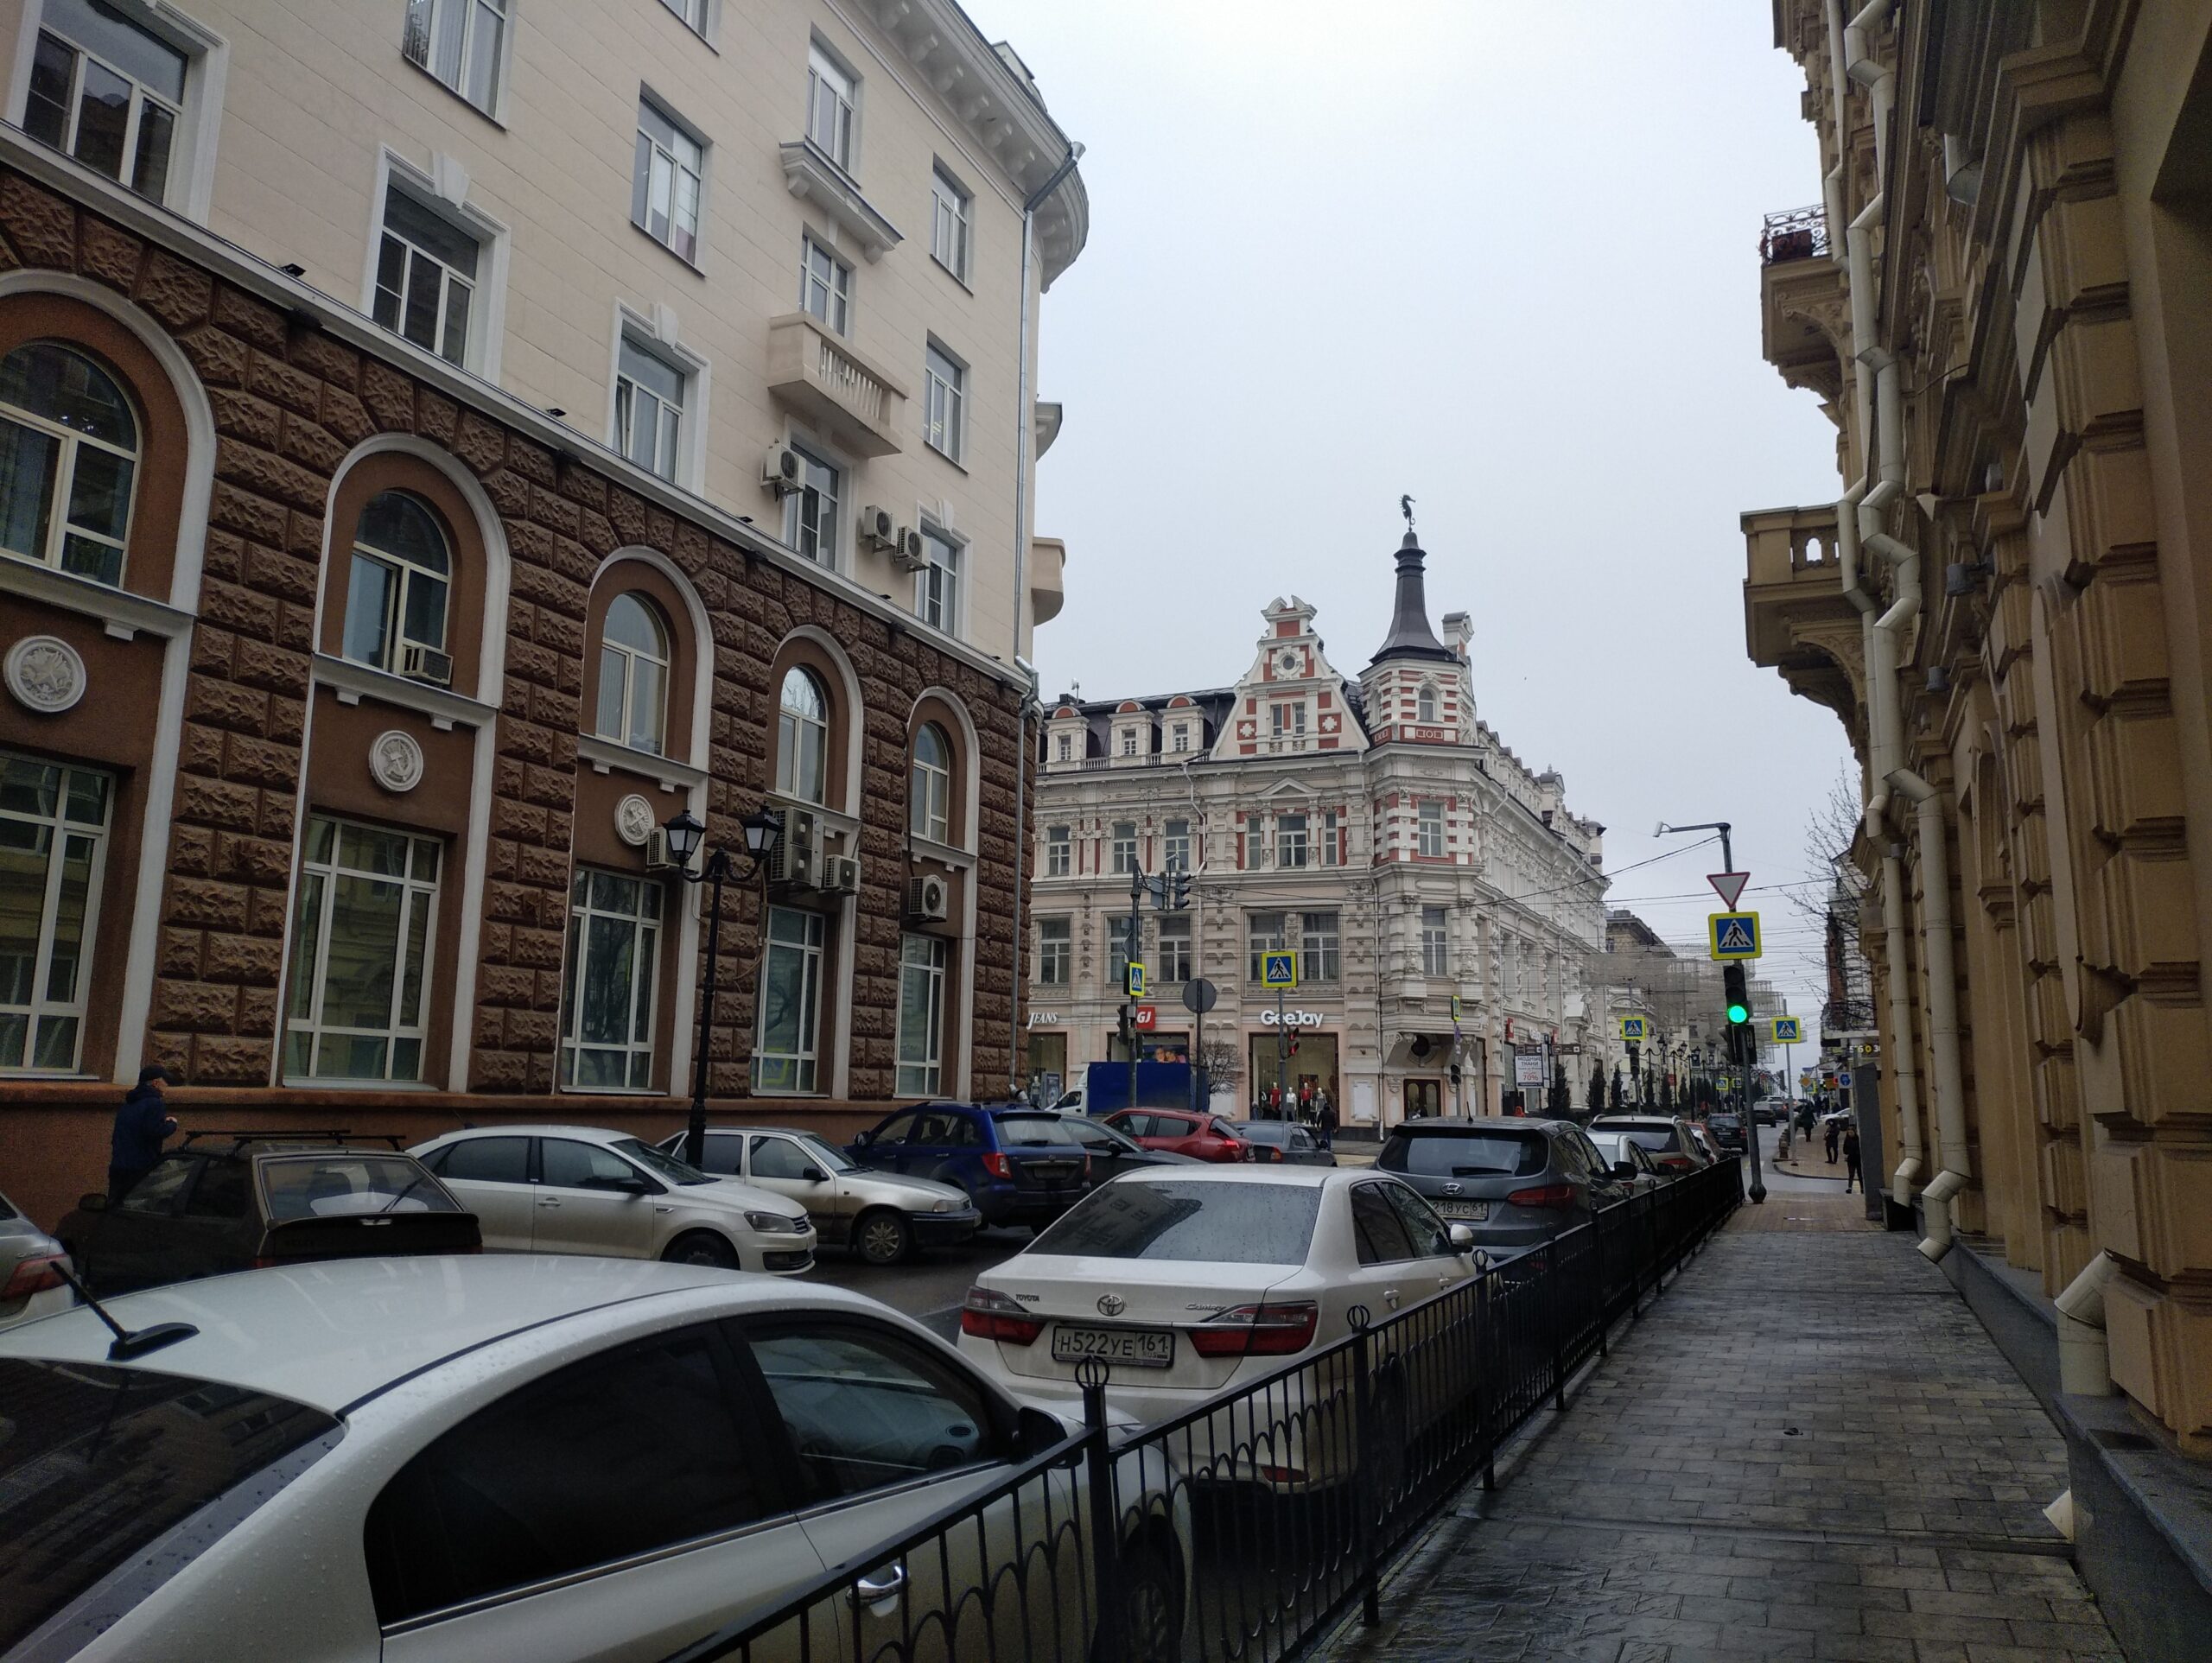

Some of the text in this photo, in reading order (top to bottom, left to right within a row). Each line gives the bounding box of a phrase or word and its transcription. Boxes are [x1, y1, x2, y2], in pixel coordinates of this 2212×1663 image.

[1026, 1012, 1058, 1030] JEANS
[1136, 1011, 1152, 1024] GJ
[1260, 1009, 1324, 1029] GeeJay
[1433, 1202, 1469, 1215] 218УС
[1015, 1293, 1040, 1302] TOYOTA
[1185, 1303, 1227, 1312] Camry
[1137, 1334, 1166, 1354] 161
